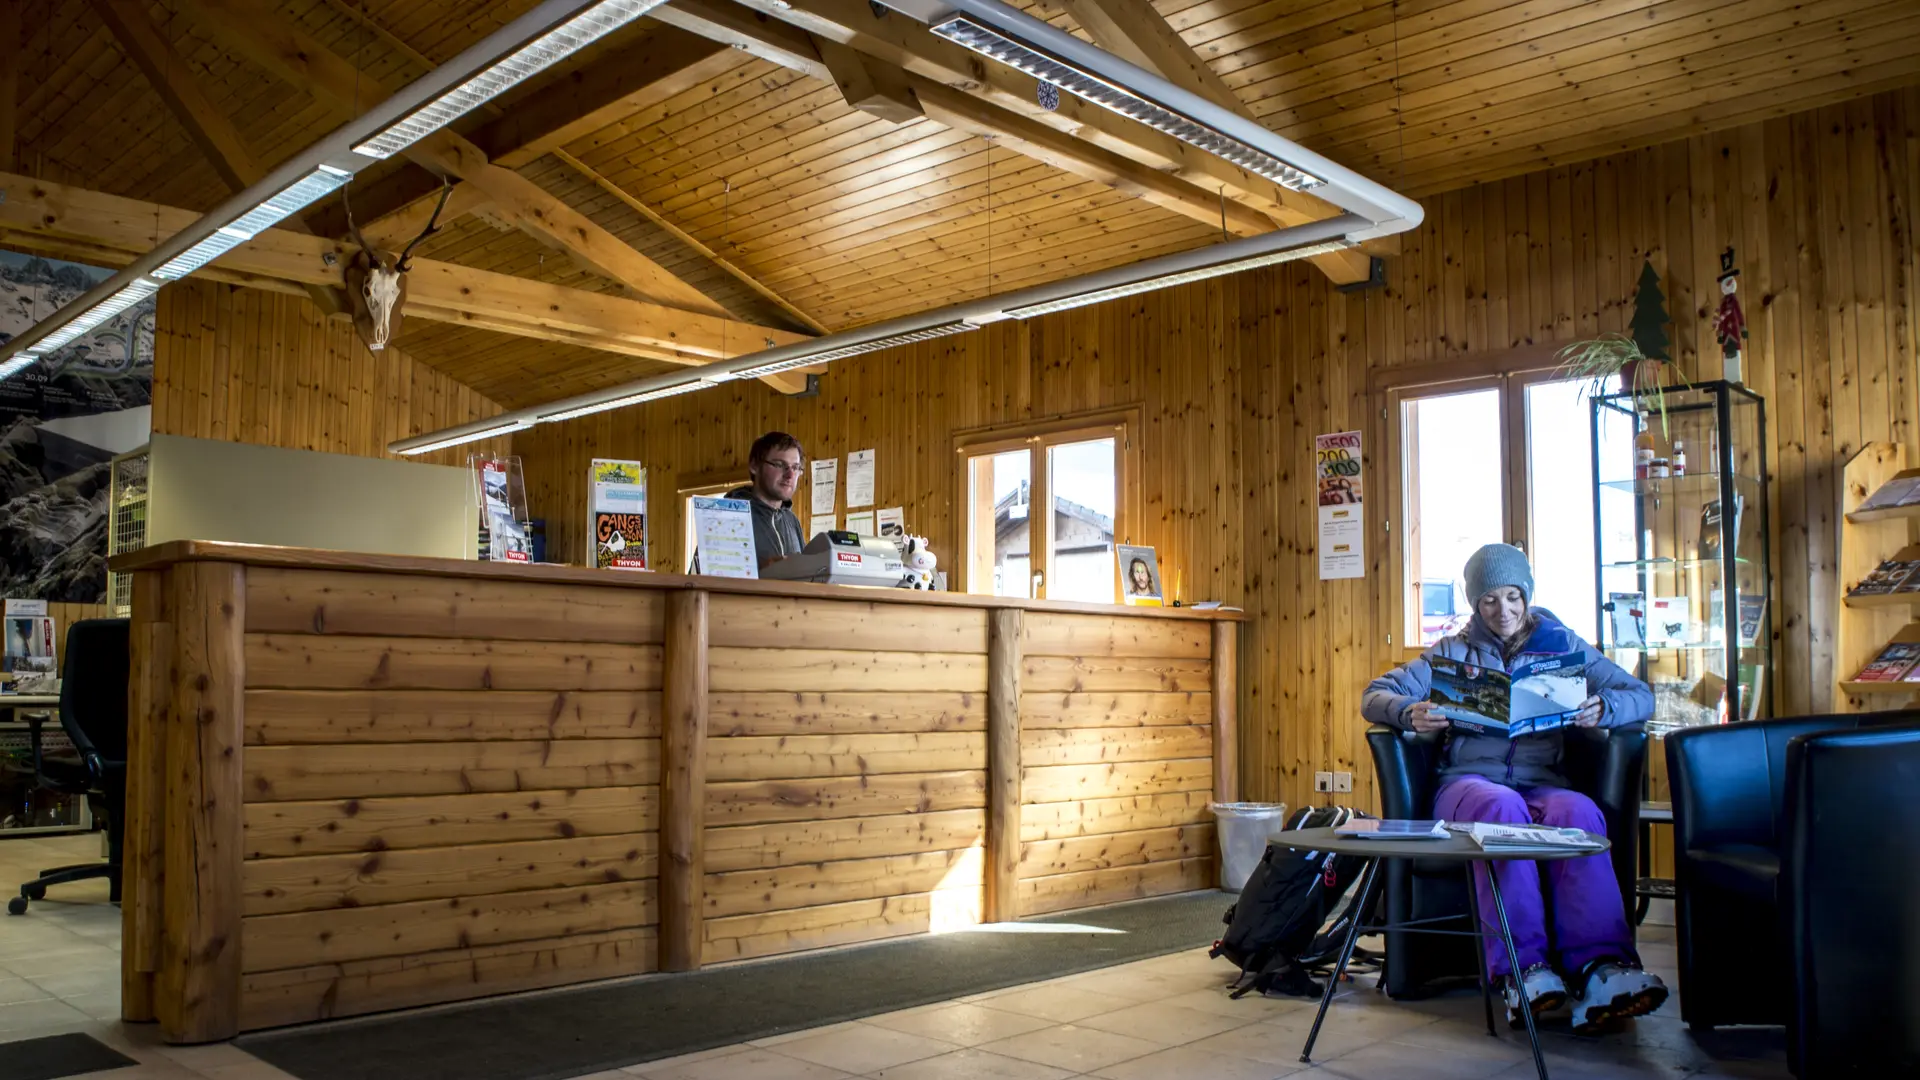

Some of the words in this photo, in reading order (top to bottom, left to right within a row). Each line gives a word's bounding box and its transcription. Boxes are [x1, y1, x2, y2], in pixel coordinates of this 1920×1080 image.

[25, 373, 48, 382] 30.09
[1330, 435, 1360, 449] 500
[1328, 460, 1360, 477] 100
[598, 514, 640, 541] GANGS
[509, 552, 525, 560] THYON
